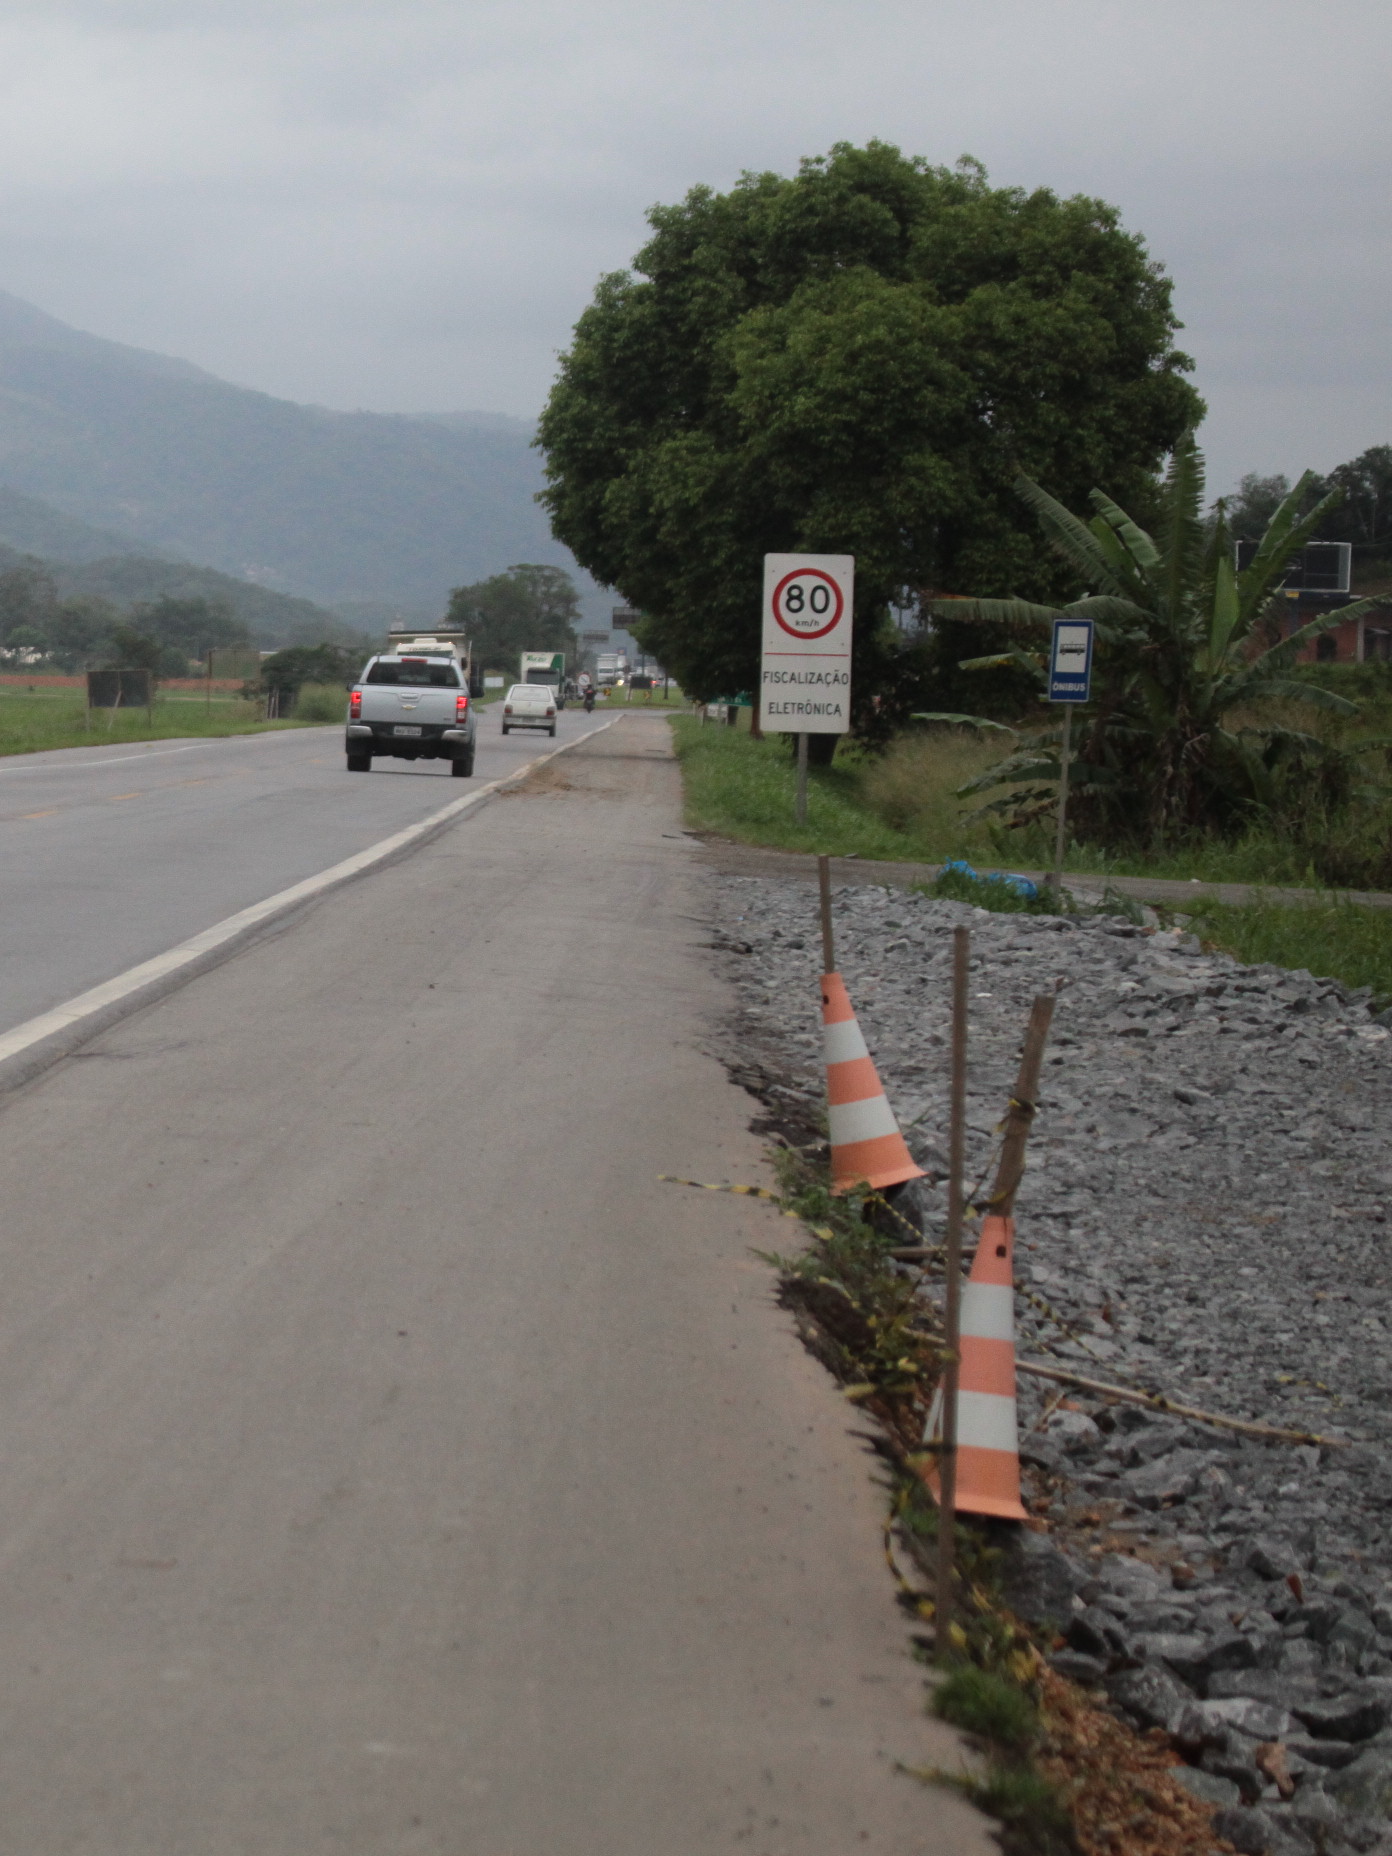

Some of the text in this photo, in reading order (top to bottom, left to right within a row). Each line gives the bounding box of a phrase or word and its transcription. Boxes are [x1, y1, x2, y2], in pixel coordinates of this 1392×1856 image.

[785, 584, 830, 614] 80
[794, 619, 820, 627] km/h
[762, 669, 849, 687] FISCALIZAÇÃO
[1052, 680, 1085, 692] ÔNIBUS
[768, 699, 842, 717] ELETRÔNICA
